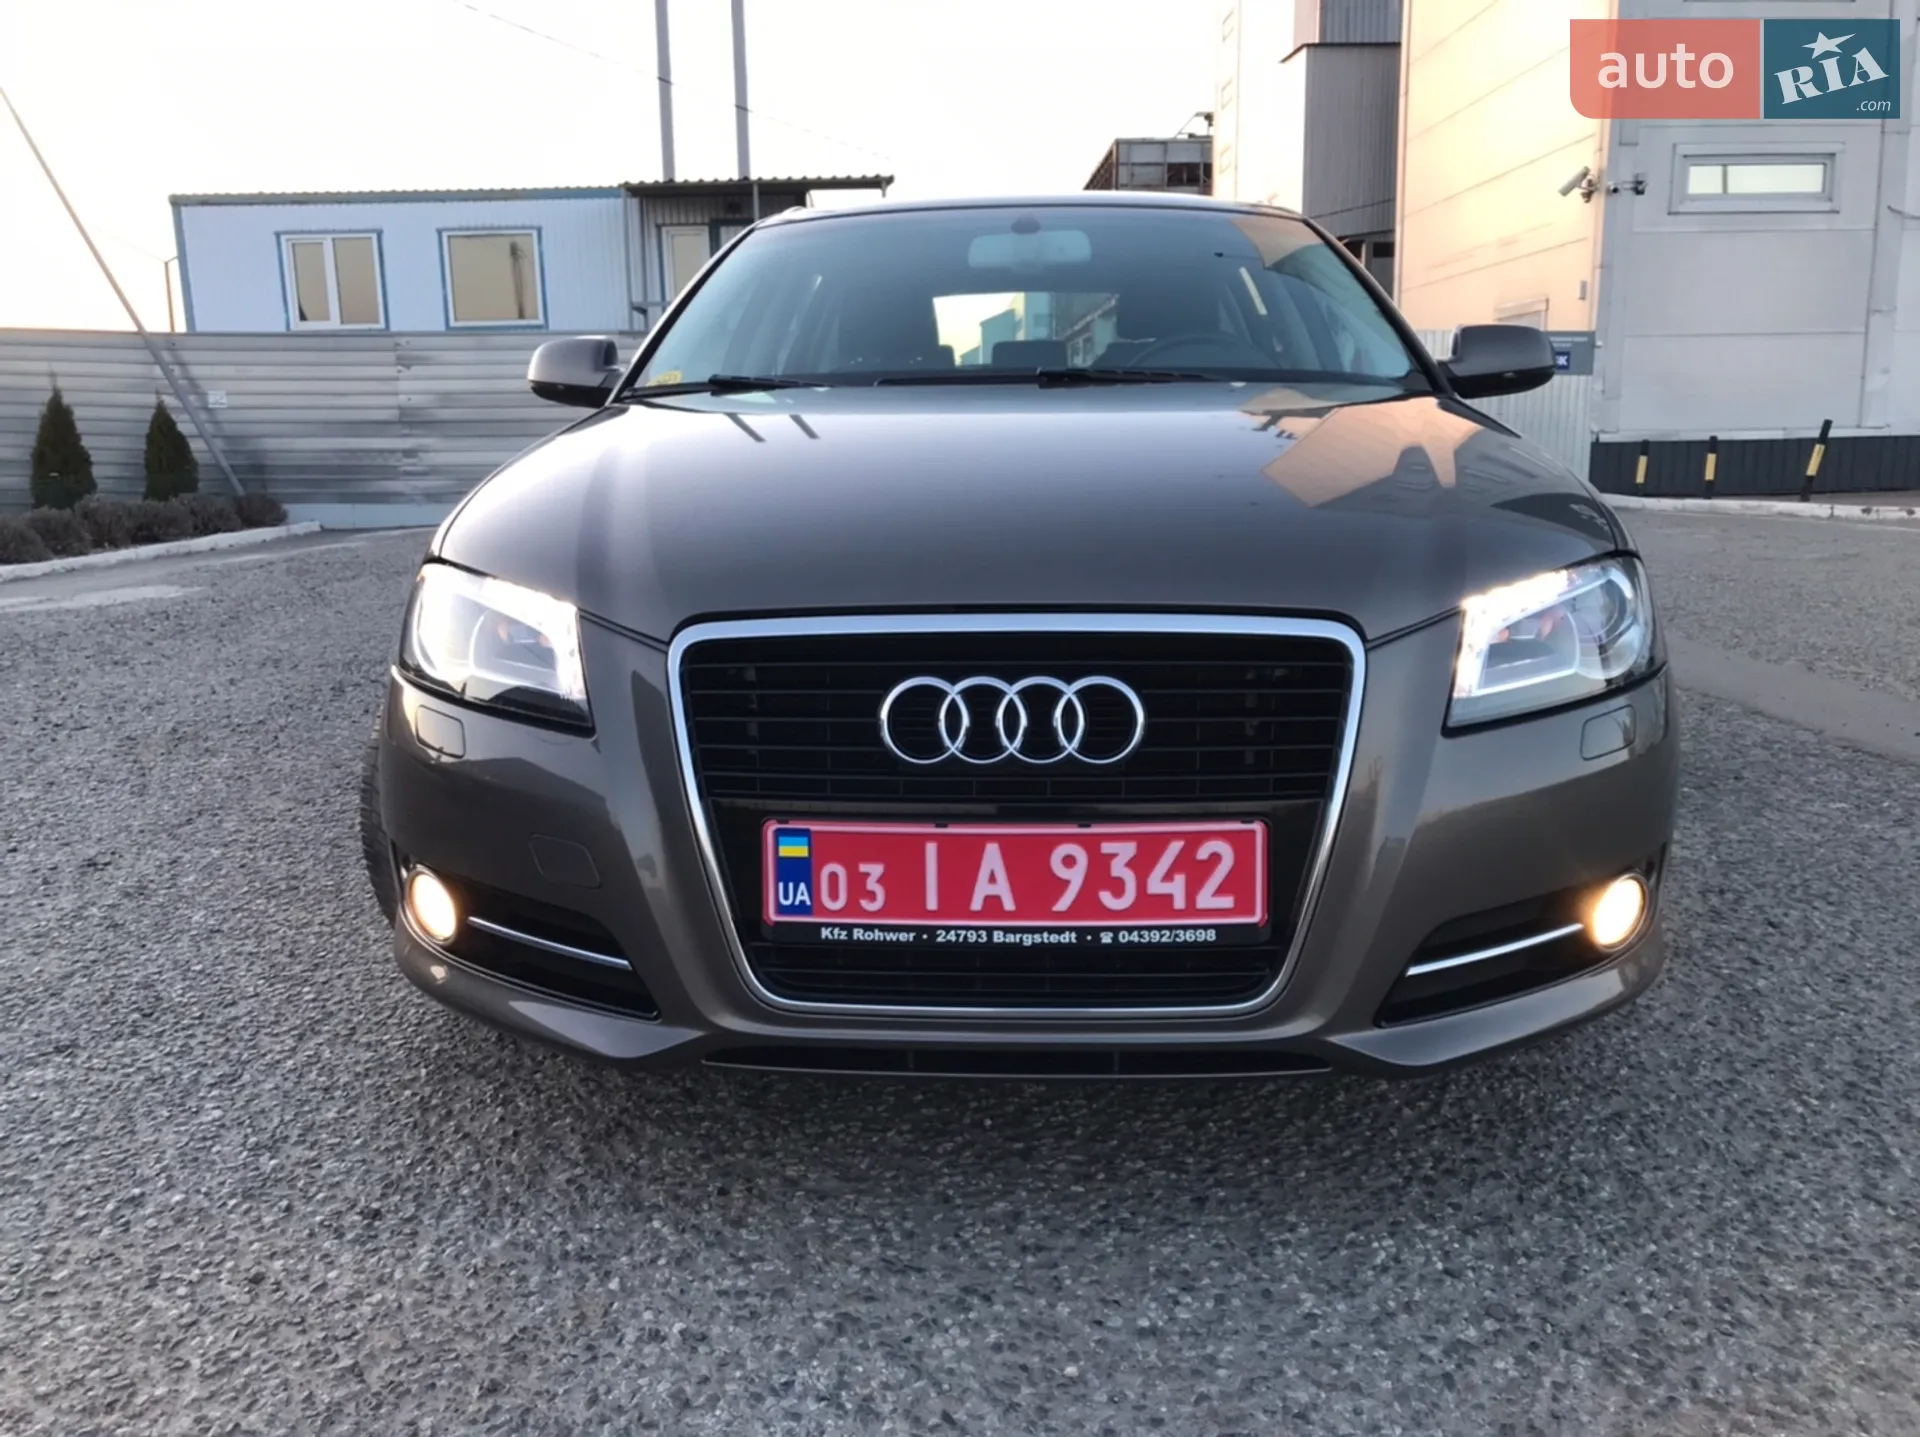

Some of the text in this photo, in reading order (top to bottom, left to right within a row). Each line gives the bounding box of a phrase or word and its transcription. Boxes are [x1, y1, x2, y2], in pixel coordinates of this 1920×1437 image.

[820, 862, 886, 912] 03
[1050, 840, 1236, 912] 9342
[778, 881, 812, 906] UA
[820, 927, 1217, 946] Kfz Rohwer 24793 Bargstedt 04392/3698
